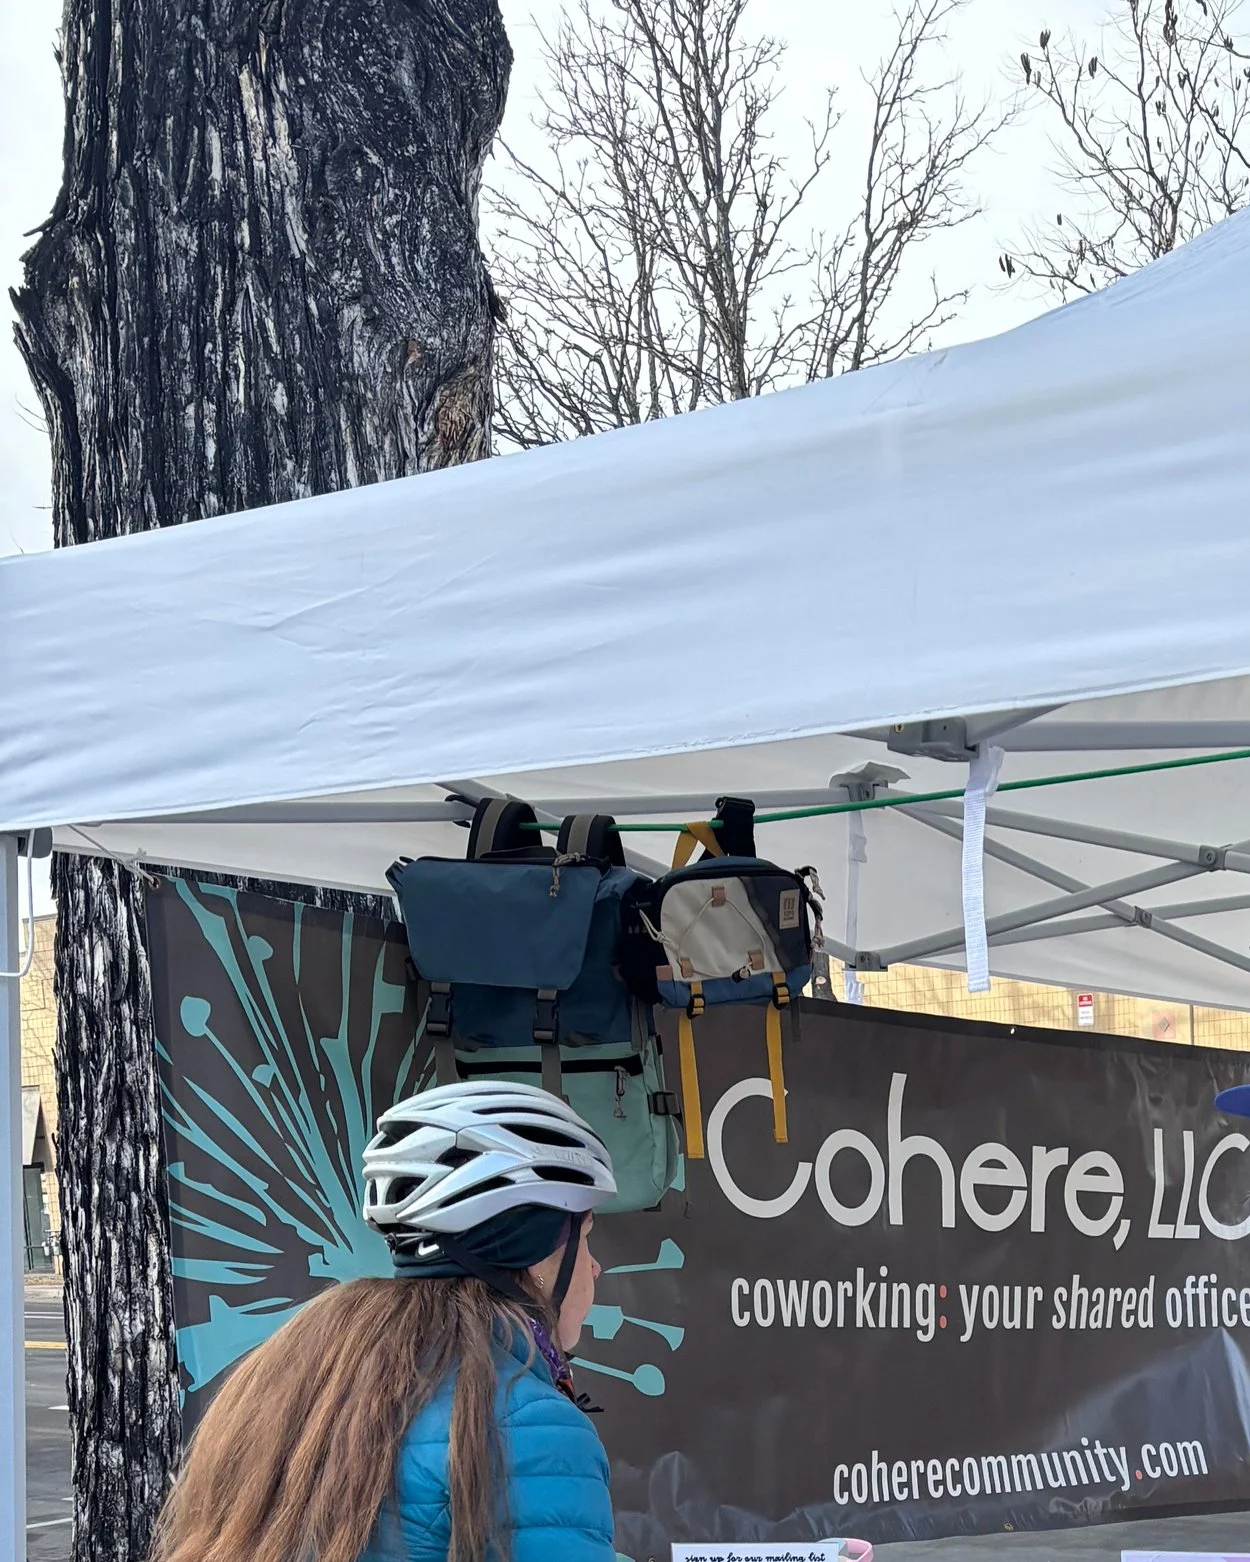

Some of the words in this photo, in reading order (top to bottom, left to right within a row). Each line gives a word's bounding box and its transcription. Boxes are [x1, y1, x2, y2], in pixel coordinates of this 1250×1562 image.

[706, 1073, 1126, 1251] Cohere,
[730, 1266, 948, 1342] coworking:
[959, 1285, 1044, 1342] your
[1052, 1274, 1155, 1330] shared
[832, 1436, 1208, 1505] coherecommunity.com
[745, 1554, 762, 1562] our
[809, 1551, 826, 1562] list
